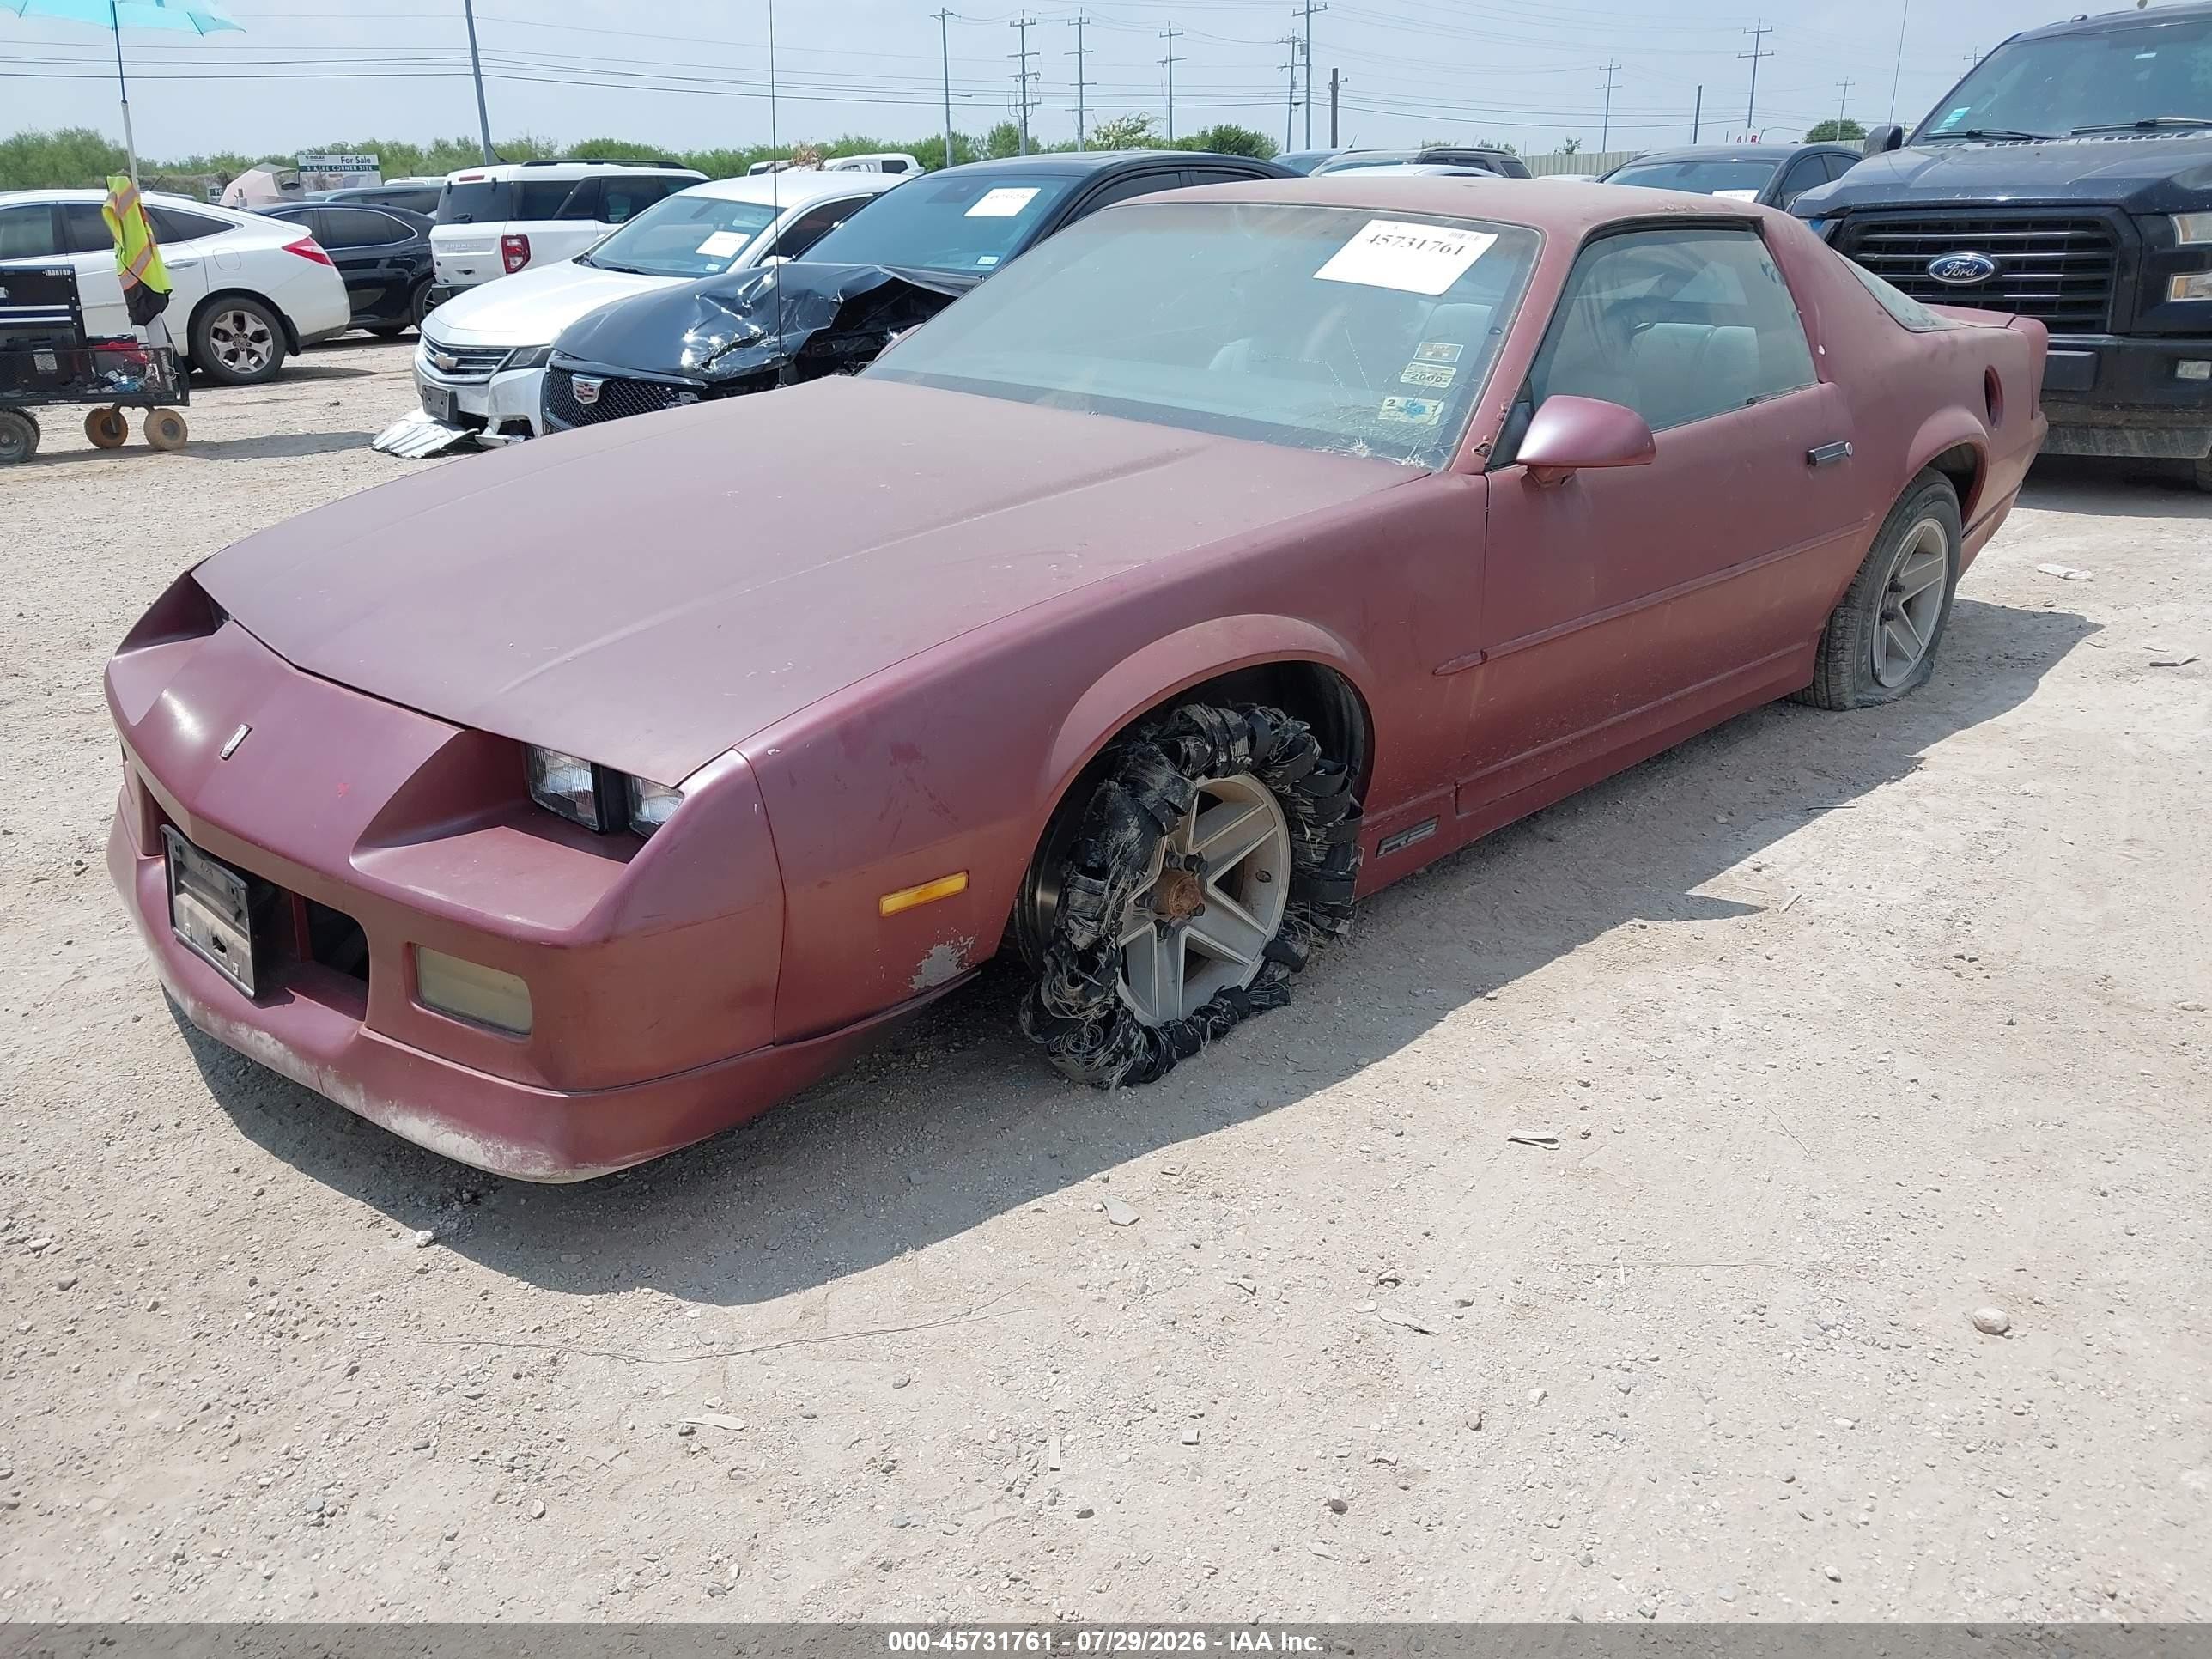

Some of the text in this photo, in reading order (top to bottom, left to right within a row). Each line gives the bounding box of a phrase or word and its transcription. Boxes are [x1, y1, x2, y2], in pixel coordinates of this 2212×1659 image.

[340, 155, 371, 164] For Sale
[1366, 233, 1467, 256] 45731761
[1942, 260, 1978, 276] Ford
[1411, 373, 1443, 383] 2000
[1387, 398, 1396, 407] 2
